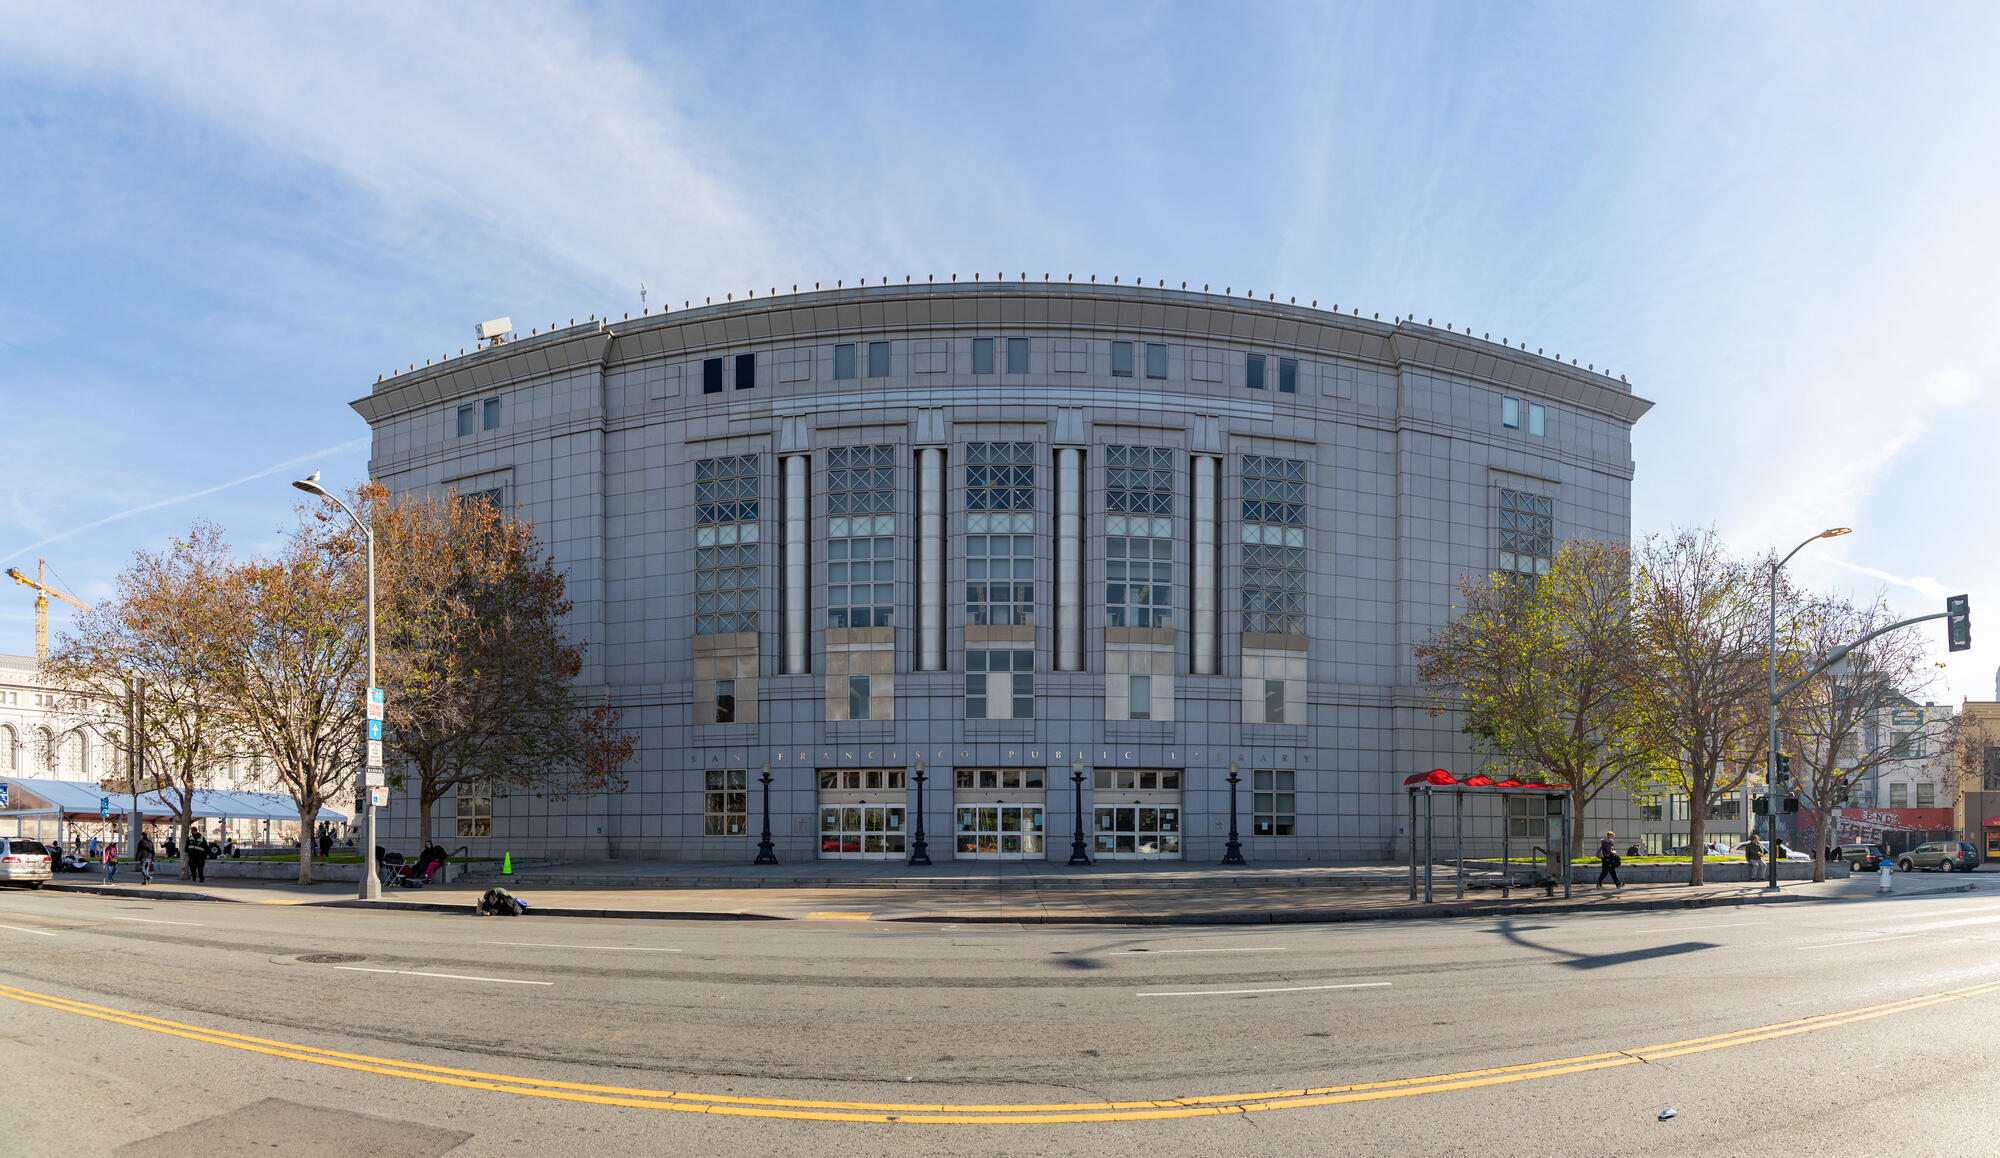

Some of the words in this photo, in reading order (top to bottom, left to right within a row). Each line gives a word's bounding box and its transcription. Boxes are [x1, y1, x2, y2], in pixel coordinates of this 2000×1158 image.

[690, 753, 741, 763] SAN
[777, 750, 969, 761] FRANCISCO
[1008, 750, 1132, 761] PUBLIC
